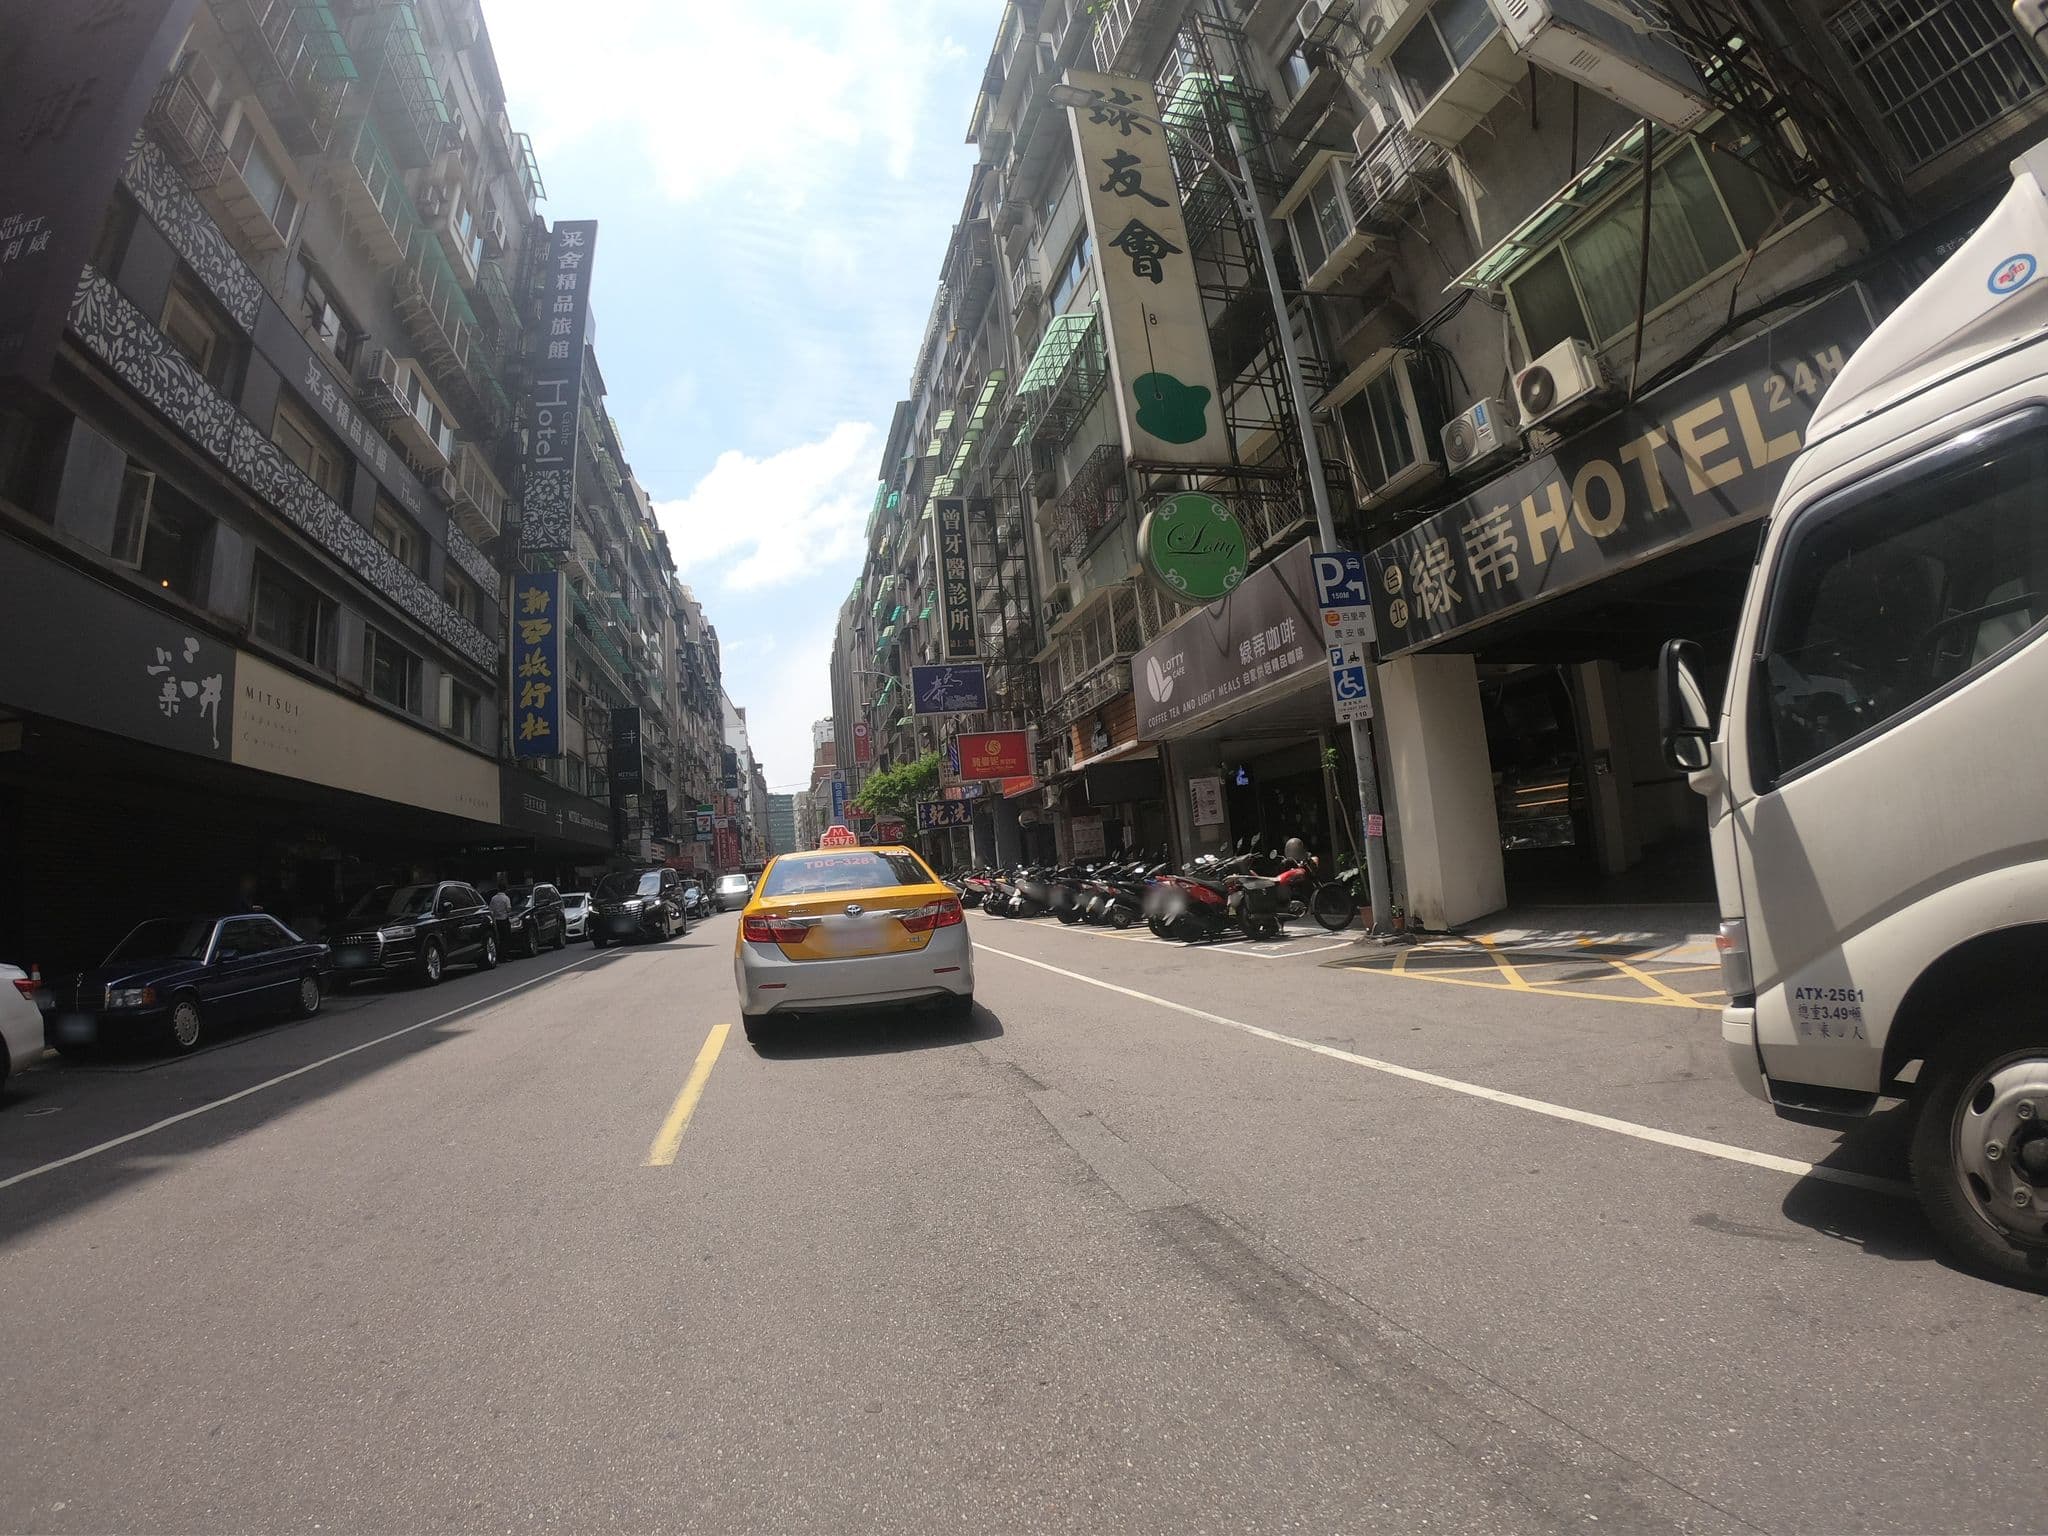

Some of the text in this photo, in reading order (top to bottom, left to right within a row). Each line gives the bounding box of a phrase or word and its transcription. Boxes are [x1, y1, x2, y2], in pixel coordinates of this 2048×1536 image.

[535, 379, 569, 463] Hotel
[1520, 383, 1802, 566] HOTEL
[1763, 344, 1845, 412] 24H
[942, 508, 970, 631] 曾牙醫診所
[1313, 557, 1345, 604] P
[1331, 591, 1350, 600] 150M
[1162, 651, 1184, 673] LOTTY
[1172, 666, 1186, 679] CAFE
[246, 686, 298, 717] MITSUI
[1148, 711, 1168, 728] COFFEE
[1169, 706, 1181, 719] TEA
[1182, 698, 1196, 713] AND
[1197, 689, 1216, 706] LIGHT
[1218, 676, 1241, 697] MEALS
[929, 802, 971, 826] 乾洗
[822, 836, 855, 847] 55178
[1795, 987, 1864, 1003] ATX-2561
